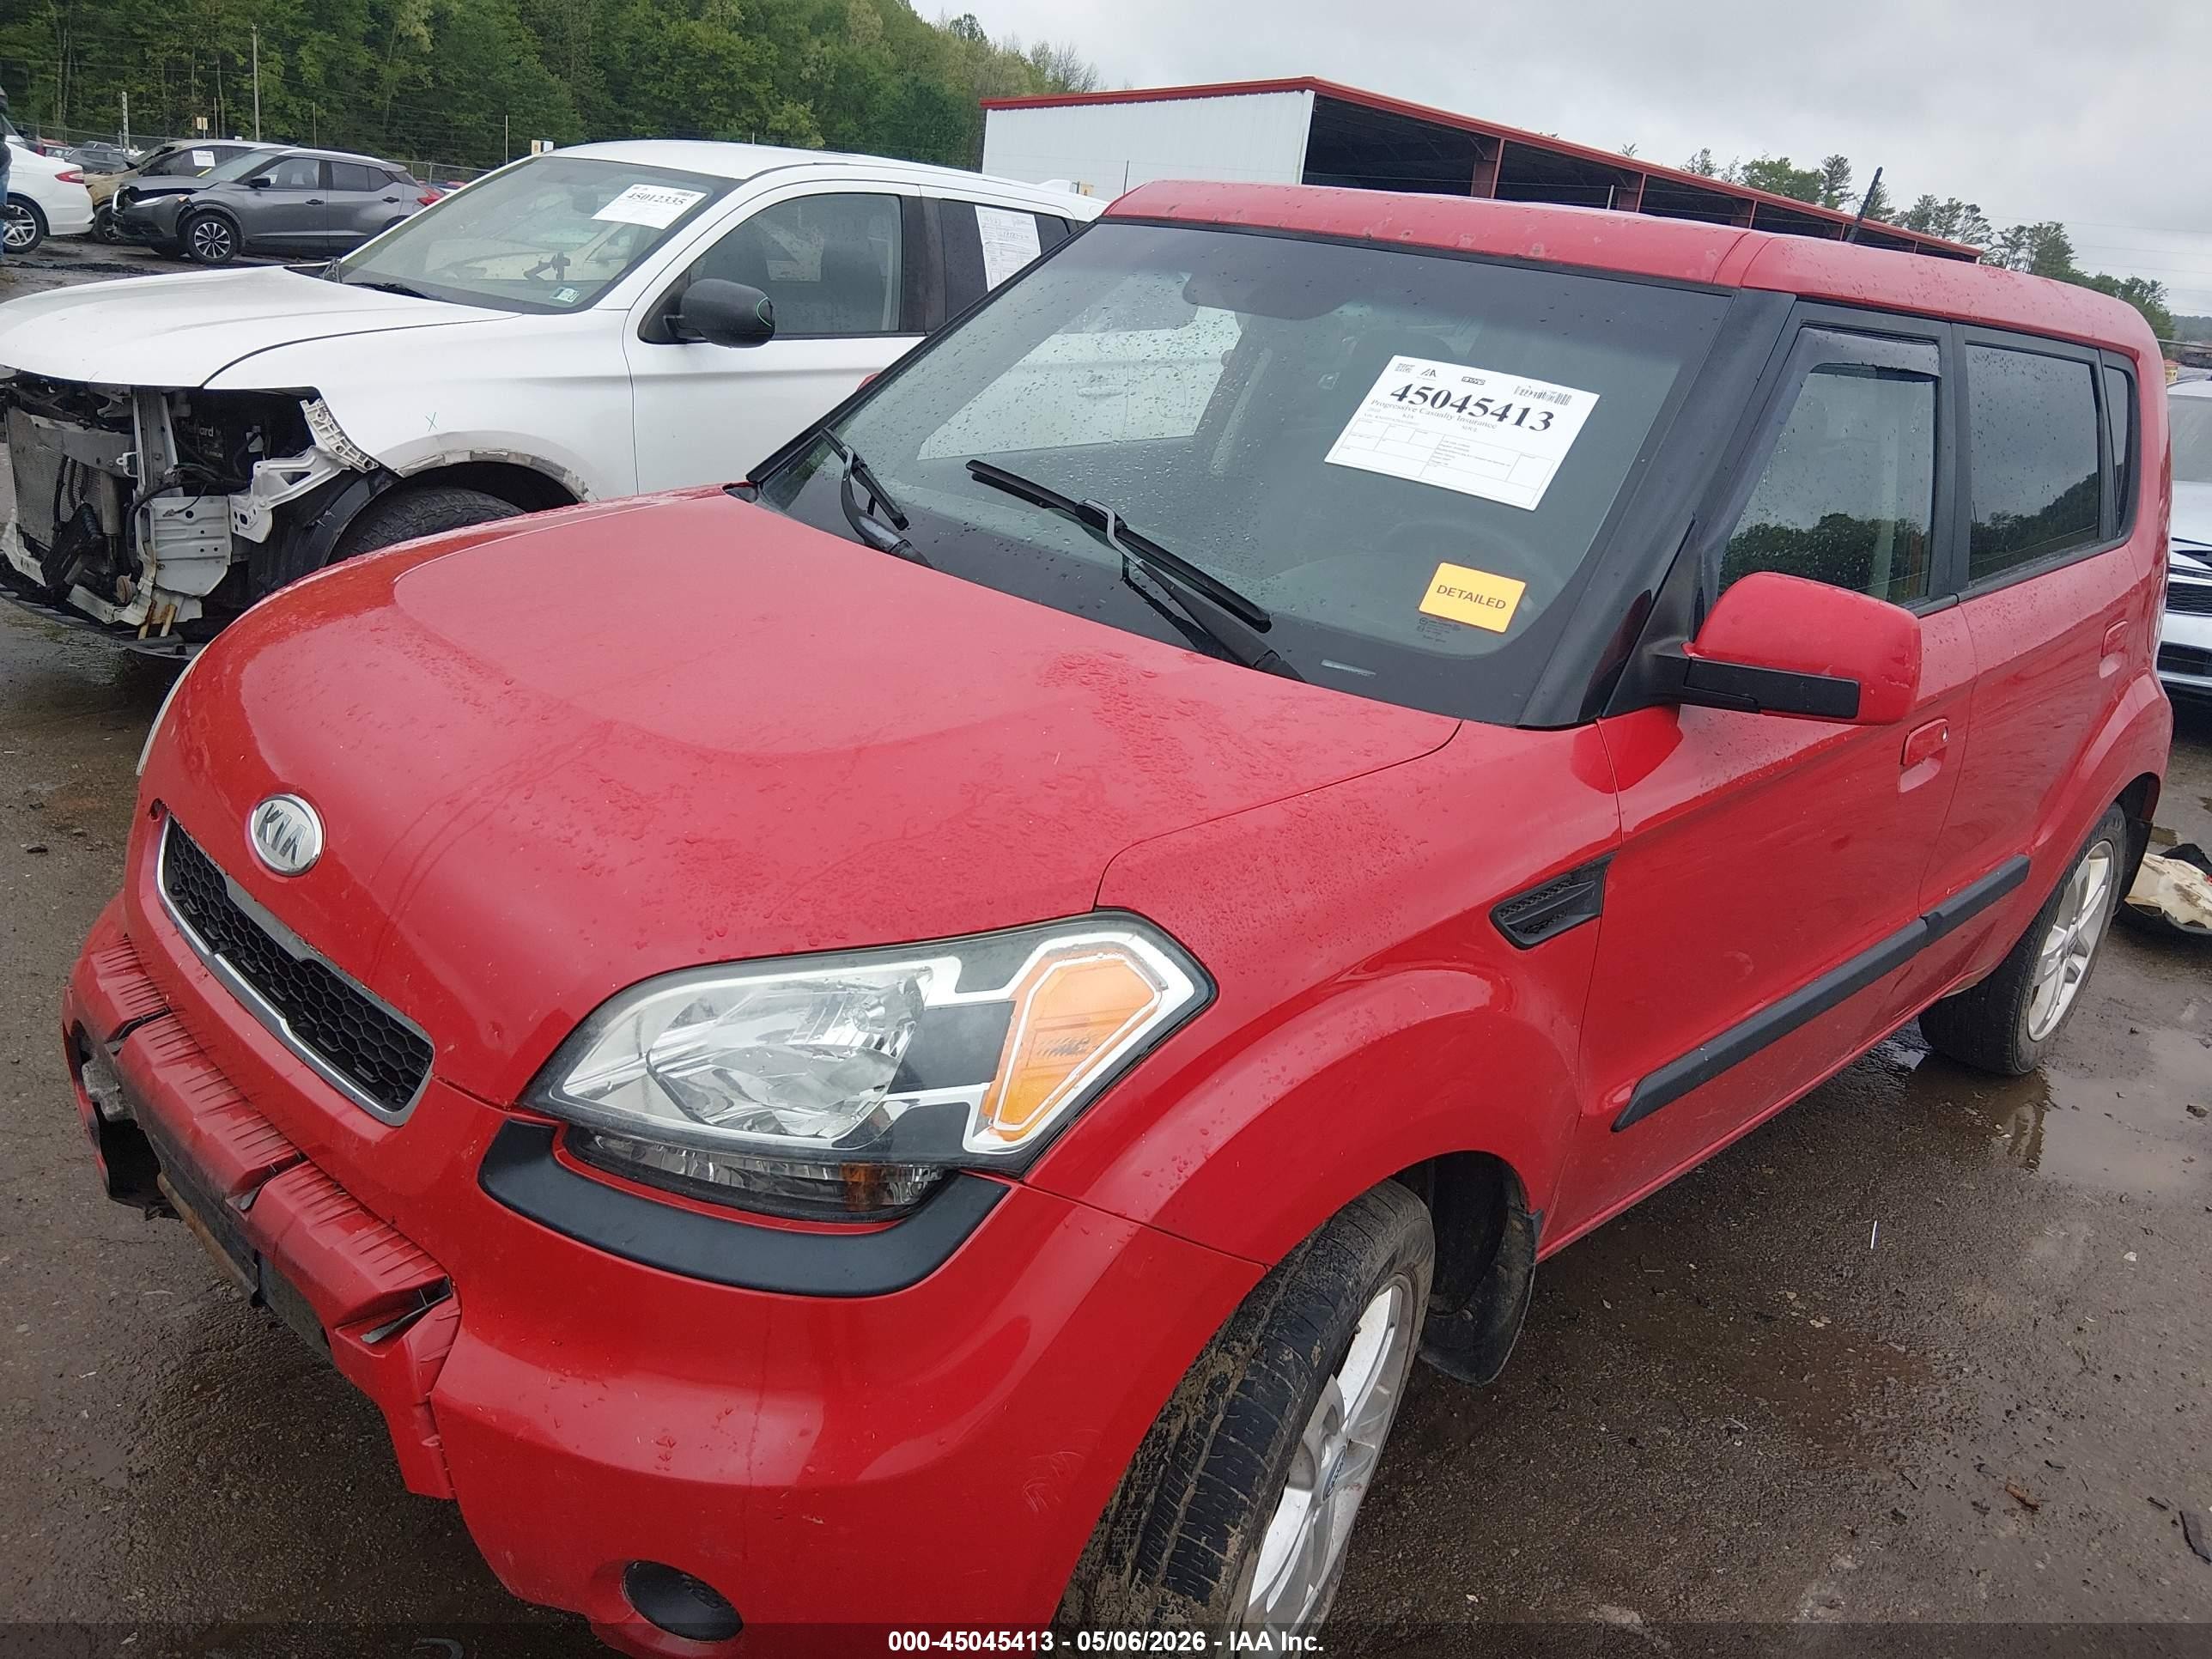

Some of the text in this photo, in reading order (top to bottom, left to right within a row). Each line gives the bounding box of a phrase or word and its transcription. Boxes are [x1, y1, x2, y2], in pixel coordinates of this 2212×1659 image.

[1370, 398, 1418, 414] Progressive
[1419, 408, 1455, 421] Casualty
[1456, 413, 1498, 429] Insurance
[1389, 383, 1555, 433] 45045413
[1436, 585, 1507, 610] DETAILED
[257, 802, 307, 866] KIA
